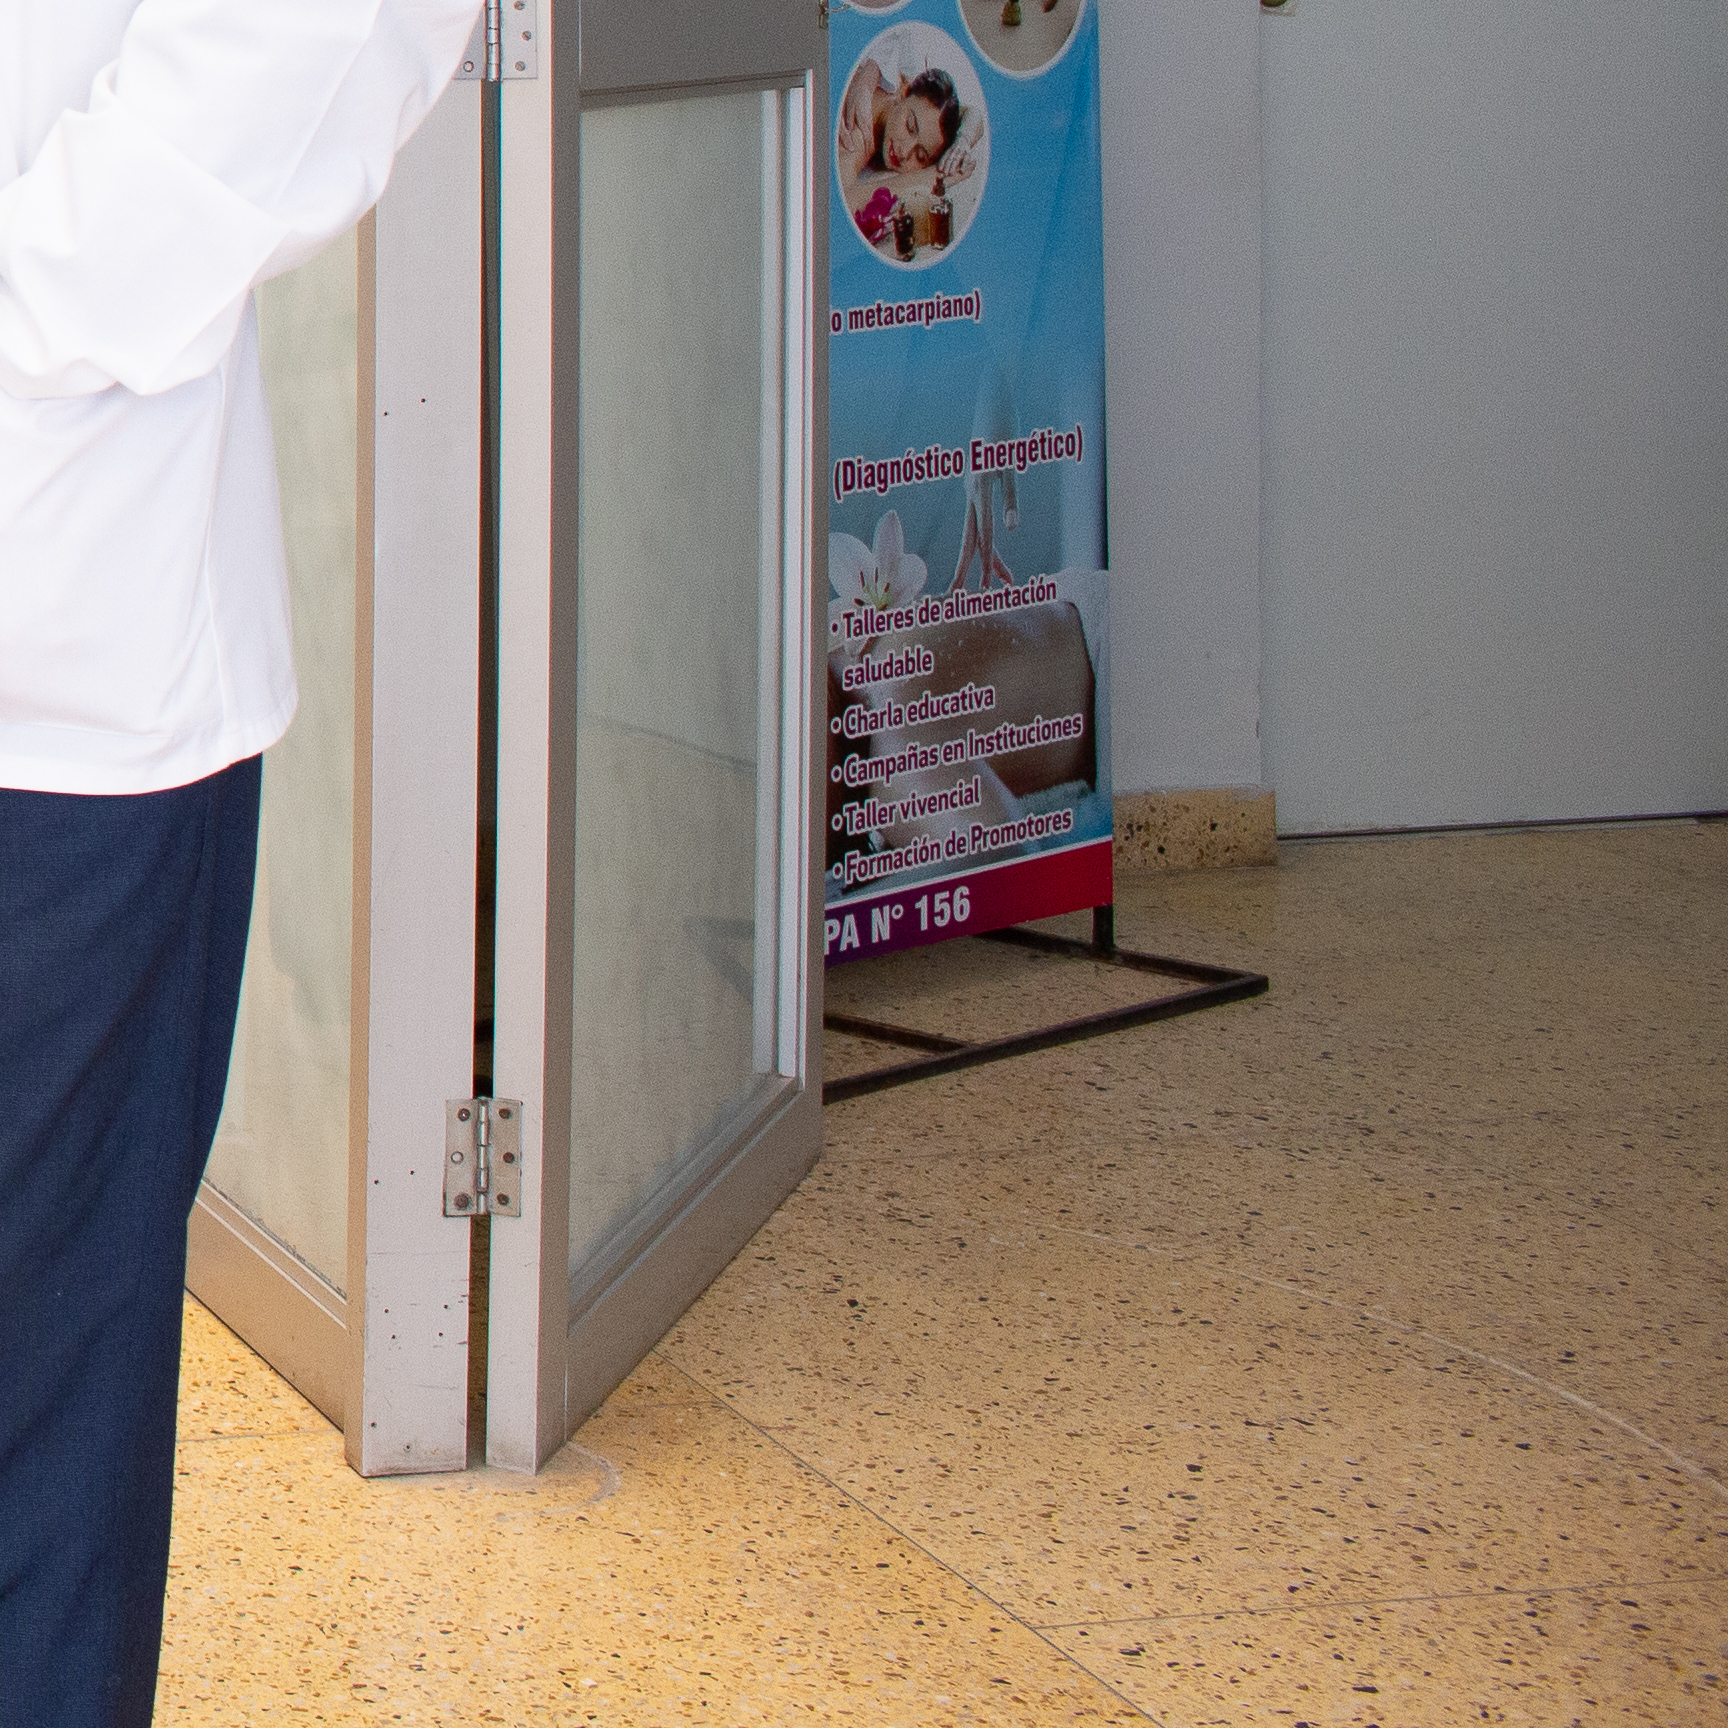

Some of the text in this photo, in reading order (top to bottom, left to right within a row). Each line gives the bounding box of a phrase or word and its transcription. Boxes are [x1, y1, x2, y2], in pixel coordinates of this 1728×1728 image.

[848, 289, 981, 330] metacarpiano)
[834, 425, 1084, 501] (Diagnóstico Energético)
[843, 579, 1058, 639] Talleres de alimentación
[843, 644, 933, 690] saludable
[844, 683, 996, 737] Charla educativa
[844, 712, 1083, 790] Campañas en Instituciones
[845, 777, 981, 836] Taller vivencial
[845, 807, 1073, 883] Formación de Promotores
[824, 912, 861, 956] PA
[914, 884, 971, 932] 156
